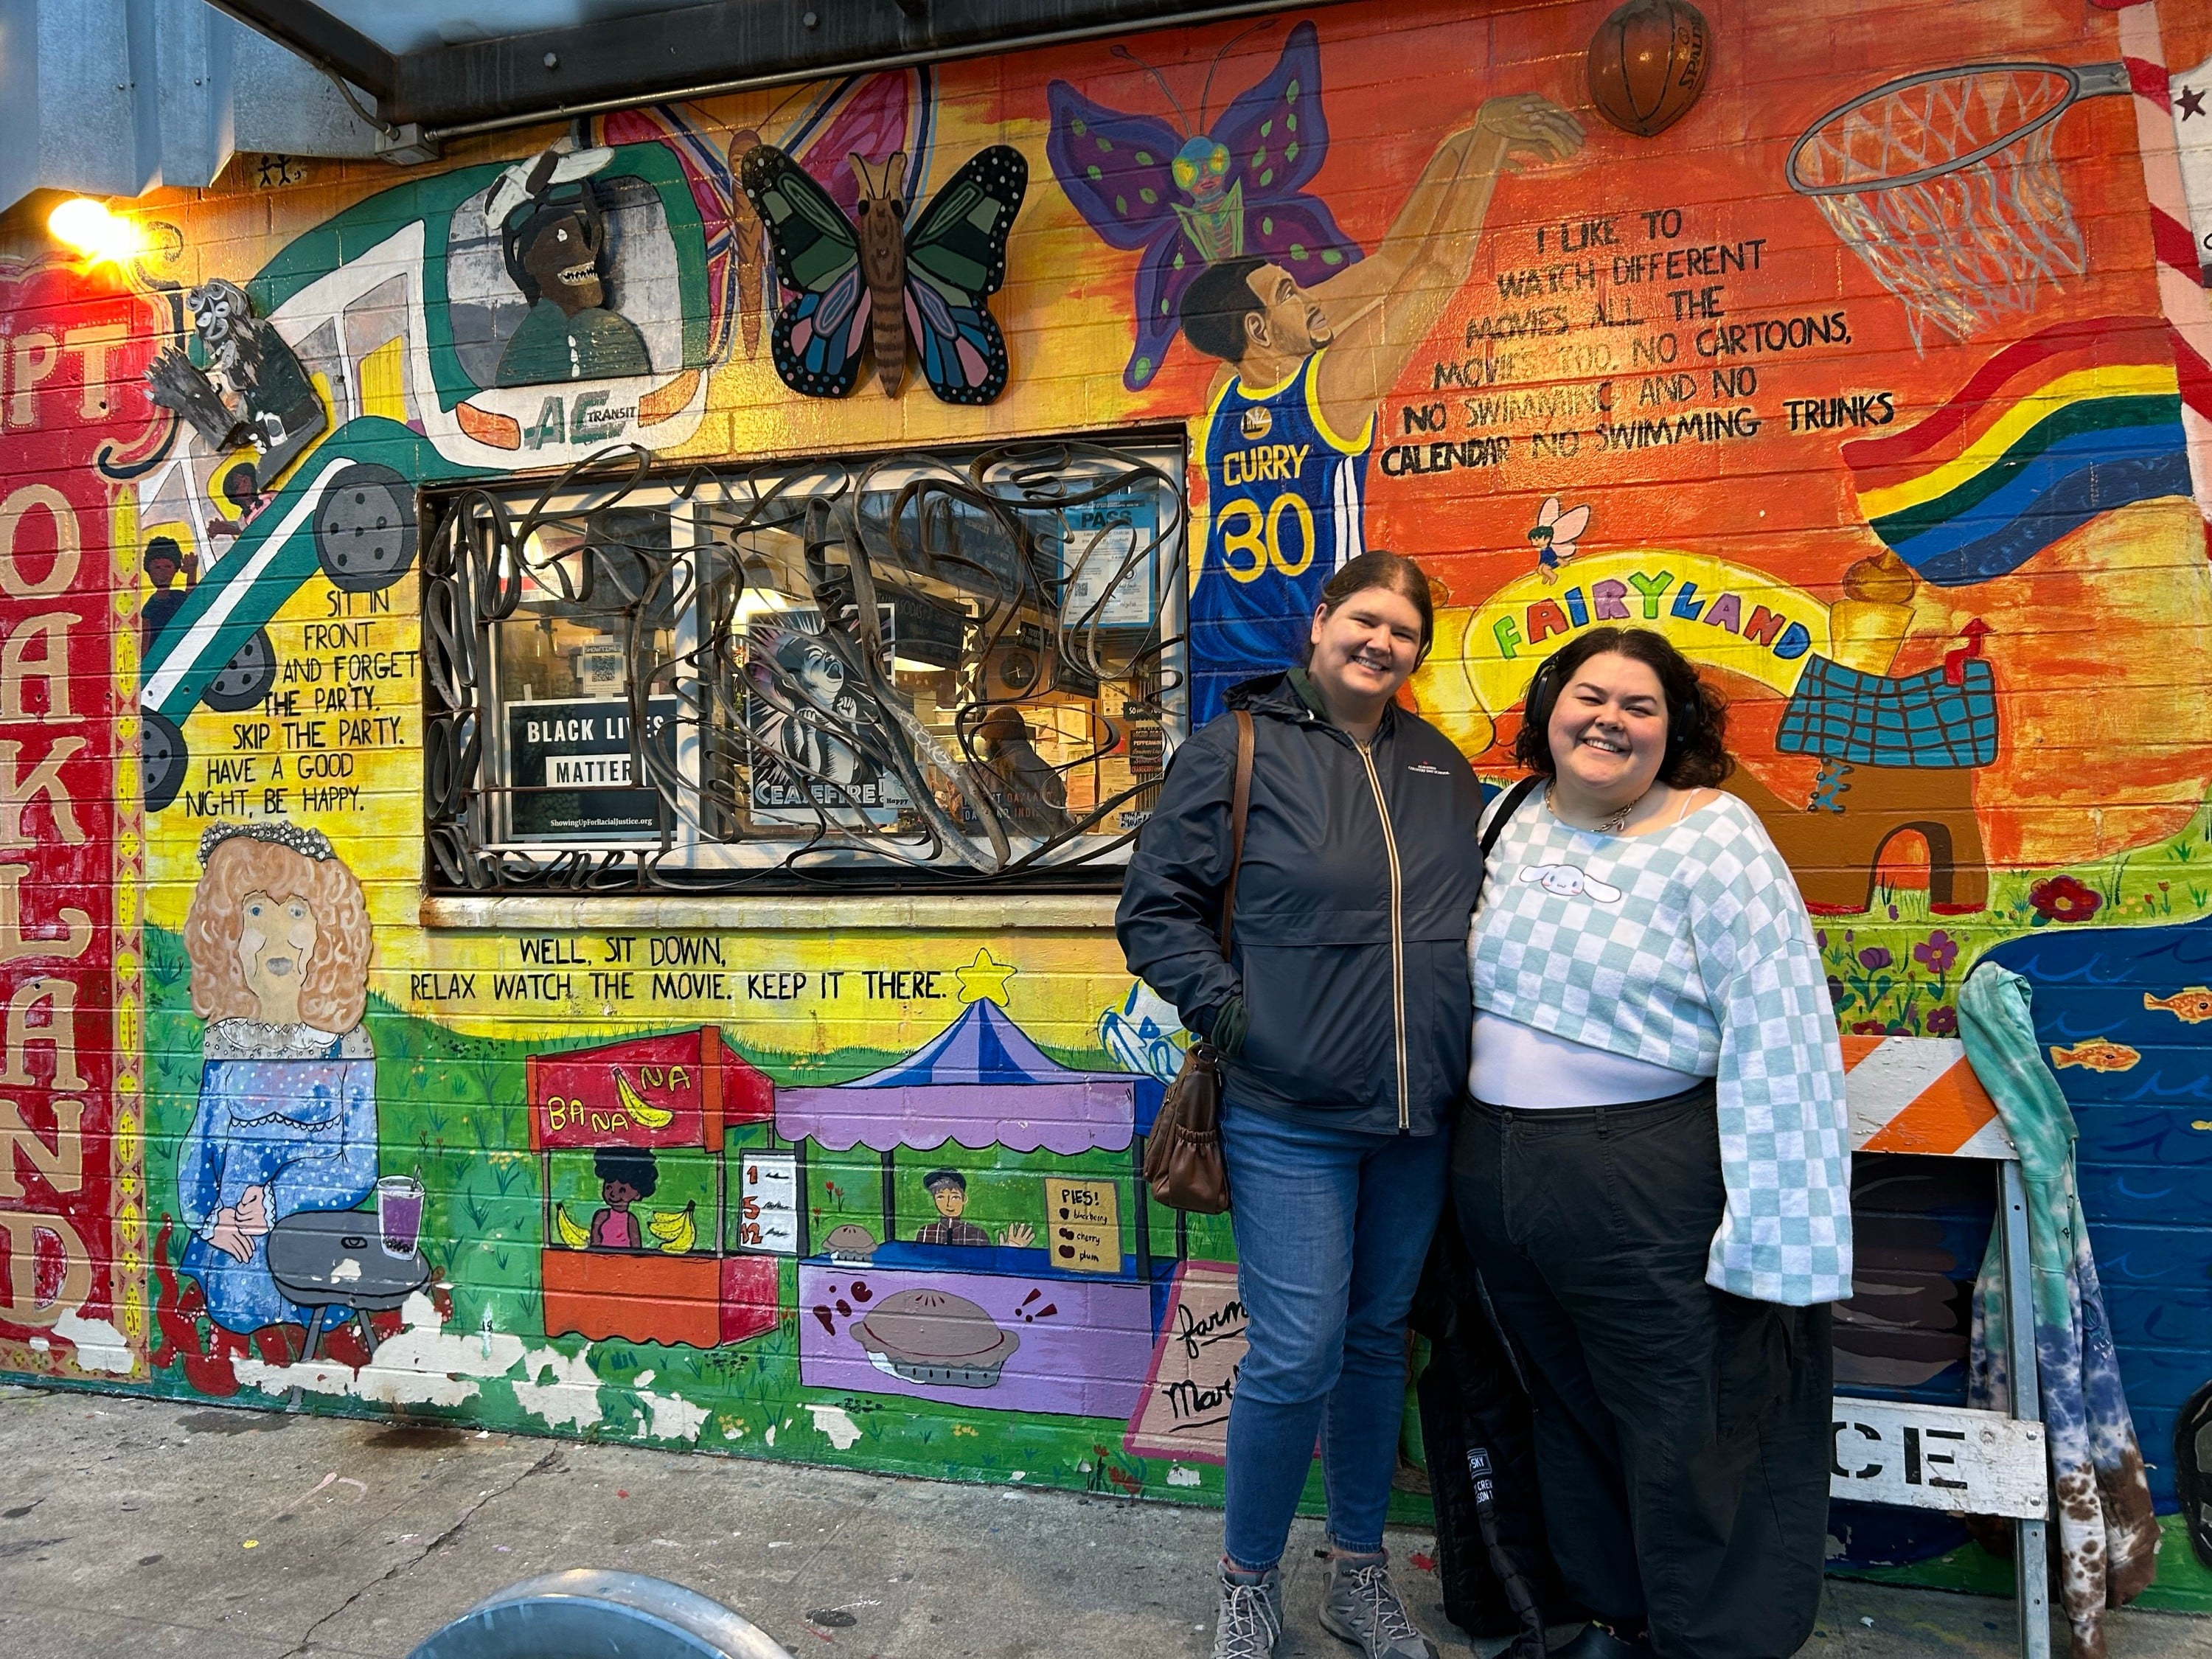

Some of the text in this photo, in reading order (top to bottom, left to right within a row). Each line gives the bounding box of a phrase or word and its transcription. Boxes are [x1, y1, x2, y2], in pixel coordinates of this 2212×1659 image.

[1537, 209, 1682, 254] I LIKE TO
[1497, 239, 1767, 299] WATCH DIFFERENT
[1466, 285, 1725, 348] MOVIES ALL THE
[1632, 333, 1678, 366] NO
[1696, 312, 1852, 358] CARTOONS,
[586, 406, 637, 422] TRANSIT
[1402, 403, 1447, 434] NO
[1638, 374, 1696, 406] AND
[1712, 366, 1756, 399] NO
[524, 389, 626, 450] AC
[1380, 392, 1895, 476] CALENDAR NO SWIMMING TRUNKS
[1223, 444, 1310, 487] CURRY
[1081, 509, 1133, 528] PASS
[1217, 492, 1315, 583] 30
[327, 588, 389, 616] SIT IN
[1492, 571, 1811, 660] FAIRYLAND
[305, 622, 375, 650] FRONT
[283, 652, 418, 683] AND FORGET
[264, 686, 380, 717] THE PARTY.
[233, 719, 405, 749] SKIP THE PARTY.
[528, 715, 664, 742] BLACK LIES
[208, 752, 354, 786] HAVE A GOOD
[556, 760, 632, 783] MATTER
[186, 785, 364, 819] NIGHT, BE HAPPY.
[550, 818, 653, 827] ShowingUpForRacialJustice.org
[520, 935, 727, 968] WELL, SIT DOWN,
[411, 970, 947, 1001] RELAX WATCH THE MOVIE. KEEP IT THERE.
[747, 1165, 758, 1185] 1
[742, 1195, 761, 1220] 5
[1062, 1189, 1099, 1206] PIES!
[740, 1222, 763, 1245] 12
[1077, 1232, 1100, 1246] cherry
[1079, 1249, 1099, 1262] plum
